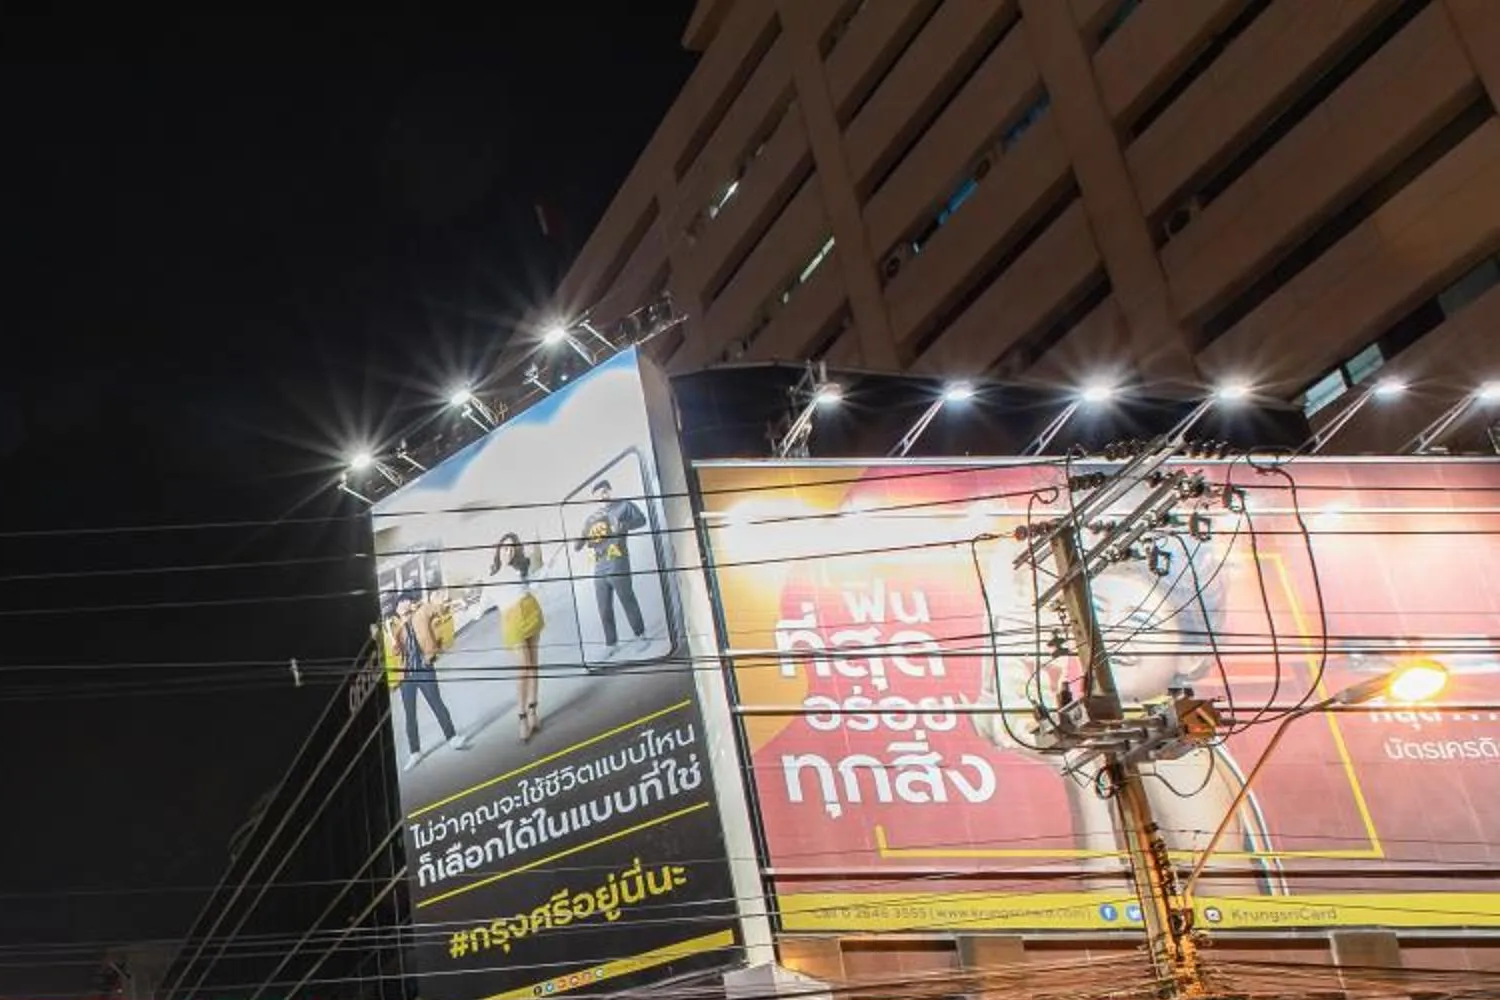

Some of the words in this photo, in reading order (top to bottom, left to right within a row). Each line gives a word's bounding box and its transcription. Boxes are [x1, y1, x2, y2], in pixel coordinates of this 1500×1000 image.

[776, 601, 946, 691] ที่สุด
[803, 686, 956, 732] อร่อย
[410, 721, 695, 849] ไม่ว่าคุณจะใช้ชีวิตแบบไหน
[417, 754, 702, 888] ก็เลือกได้ในแบบที่ใช่
[781, 731, 997, 818] ทุกสิ่ง
[449, 858, 686, 959] #กรุงศรีอยู่นี่นะ
